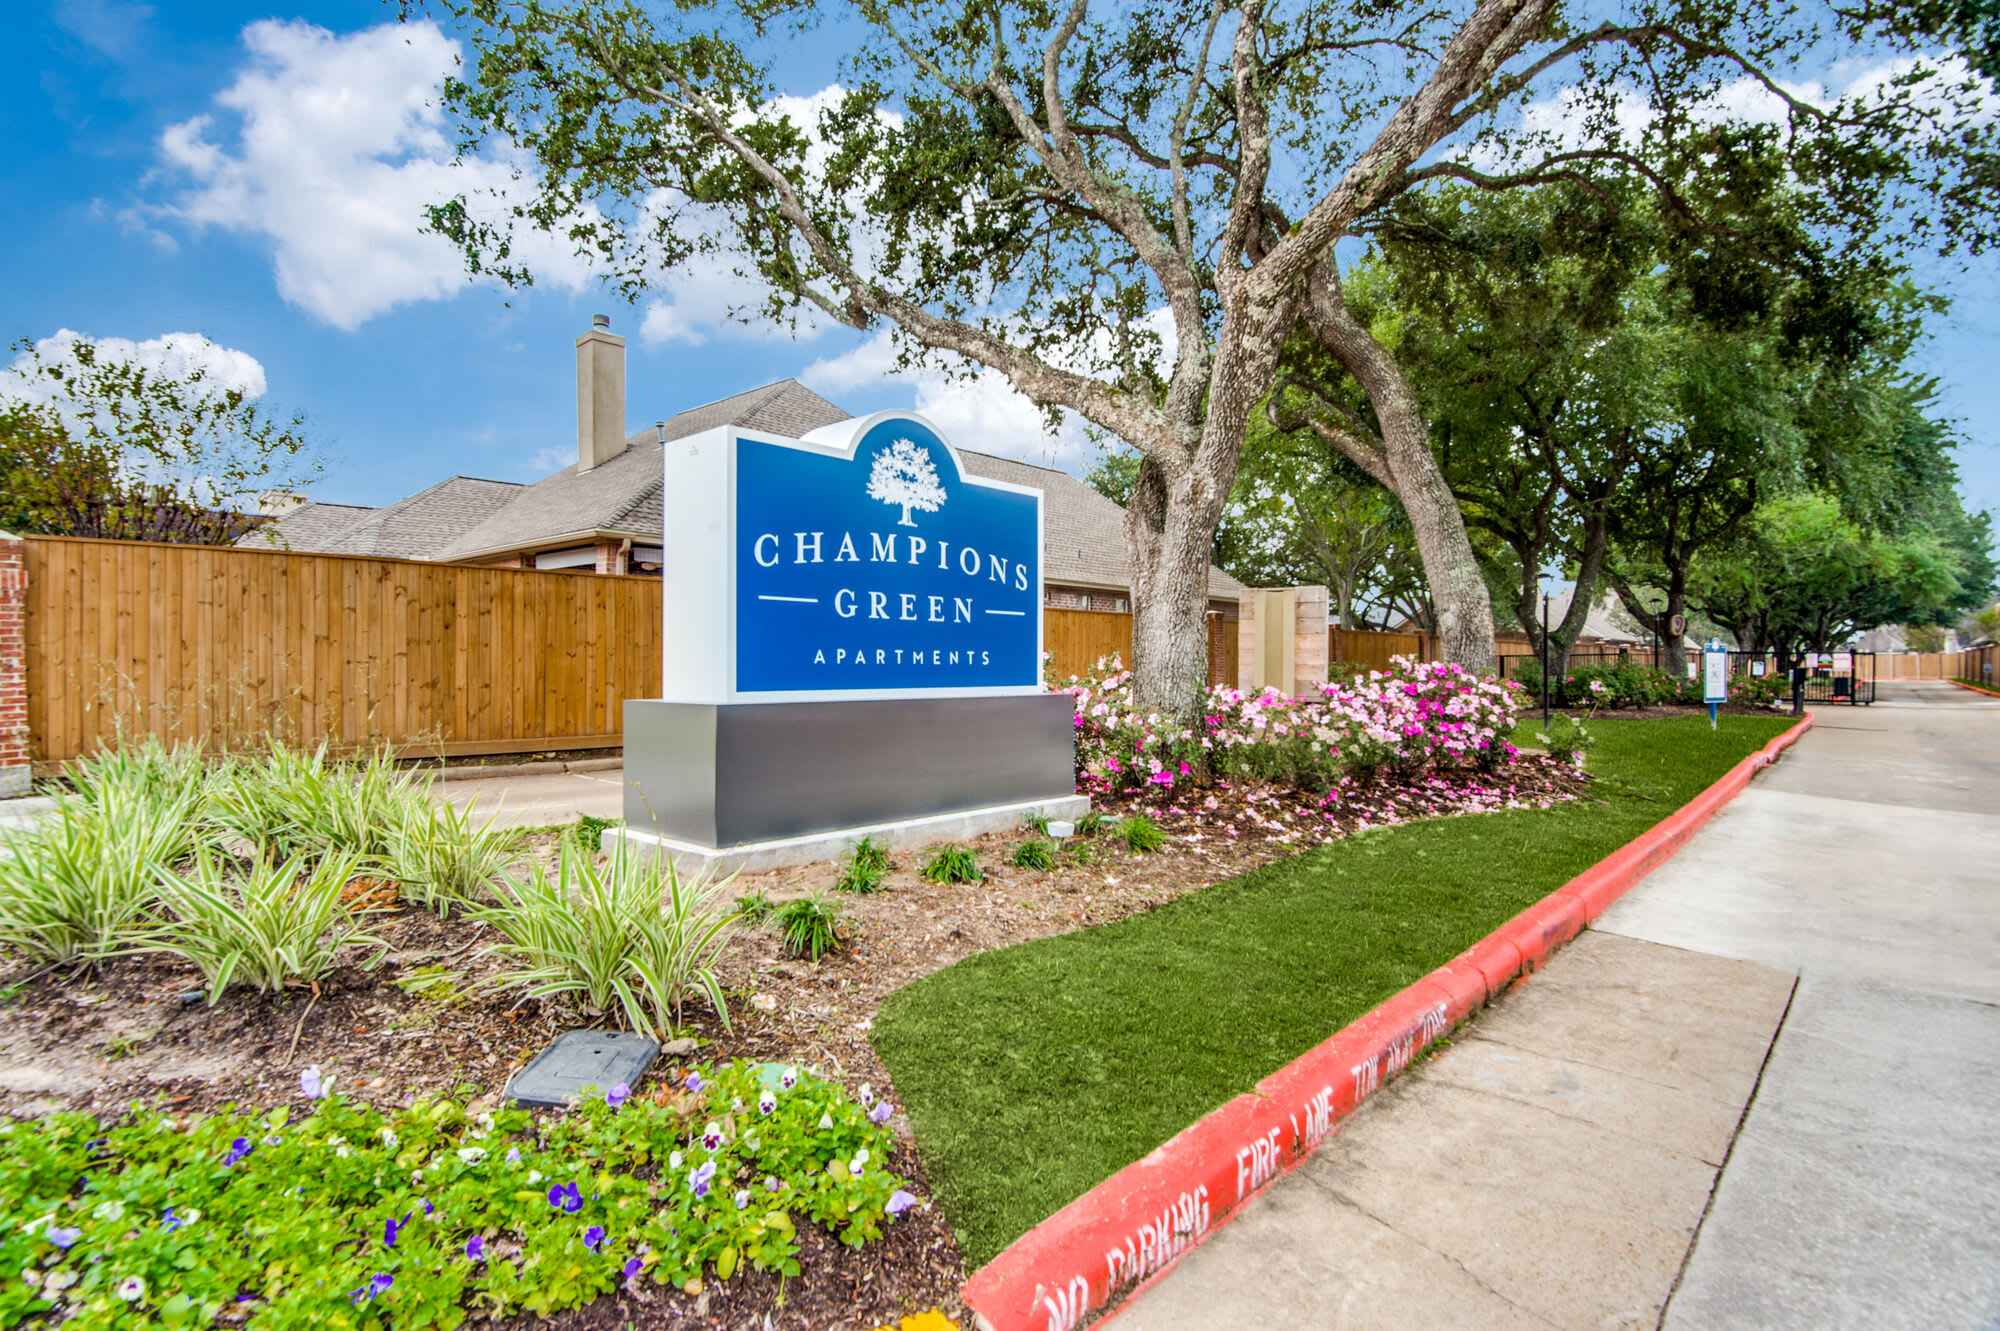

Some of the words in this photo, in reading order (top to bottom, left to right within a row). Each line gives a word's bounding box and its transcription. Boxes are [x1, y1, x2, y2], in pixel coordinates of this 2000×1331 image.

[754, 531, 1028, 591] CHAMPIONS
[834, 588, 973, 623] GREEN
[813, 648, 990, 666] APARTMENTS
[1043, 1275, 1089, 1331] NO
[1106, 1184, 1210, 1301] PARKING
[1236, 1126, 1280, 1200] FIRE
[1351, 1054, 1379, 1103] TOW
